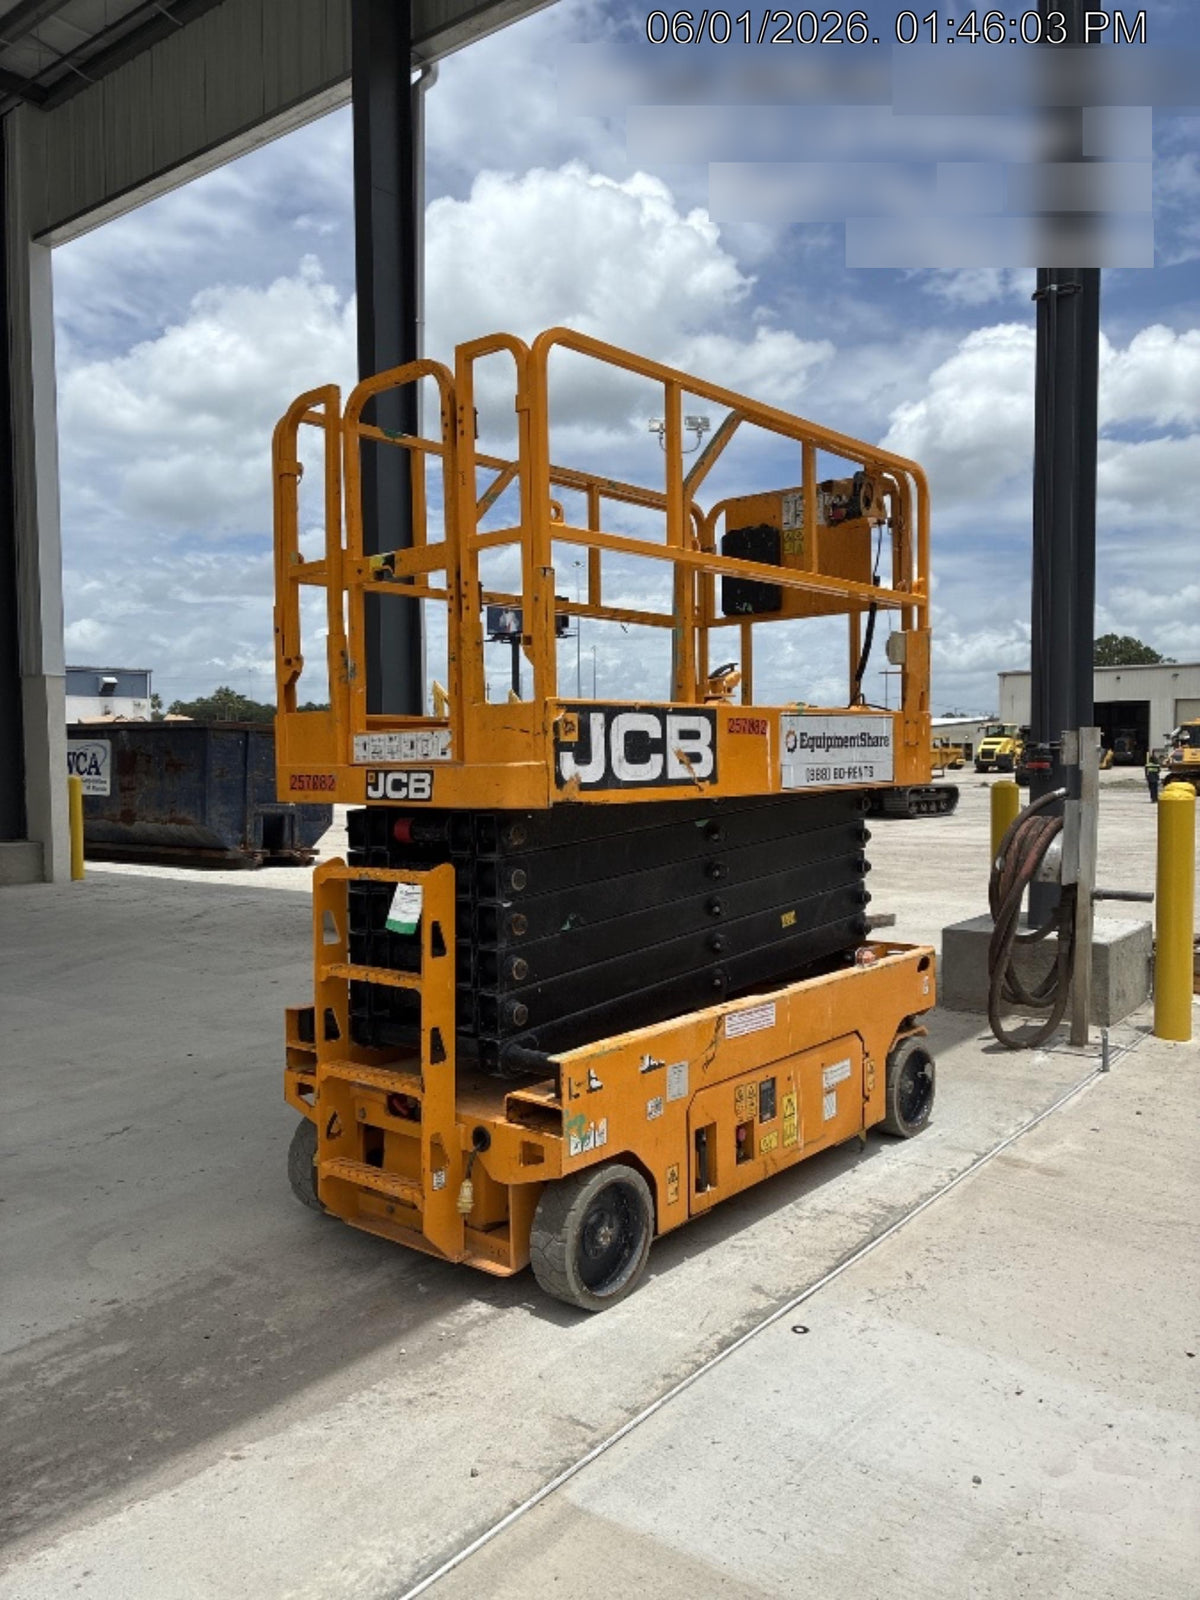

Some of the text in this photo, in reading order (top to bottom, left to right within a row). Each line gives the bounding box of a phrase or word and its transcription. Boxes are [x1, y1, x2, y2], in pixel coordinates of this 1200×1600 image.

[559, 712, 714, 783] JCB
[799, 732, 890, 753] EquipmentShare
[368, 772, 431, 799] JCB
